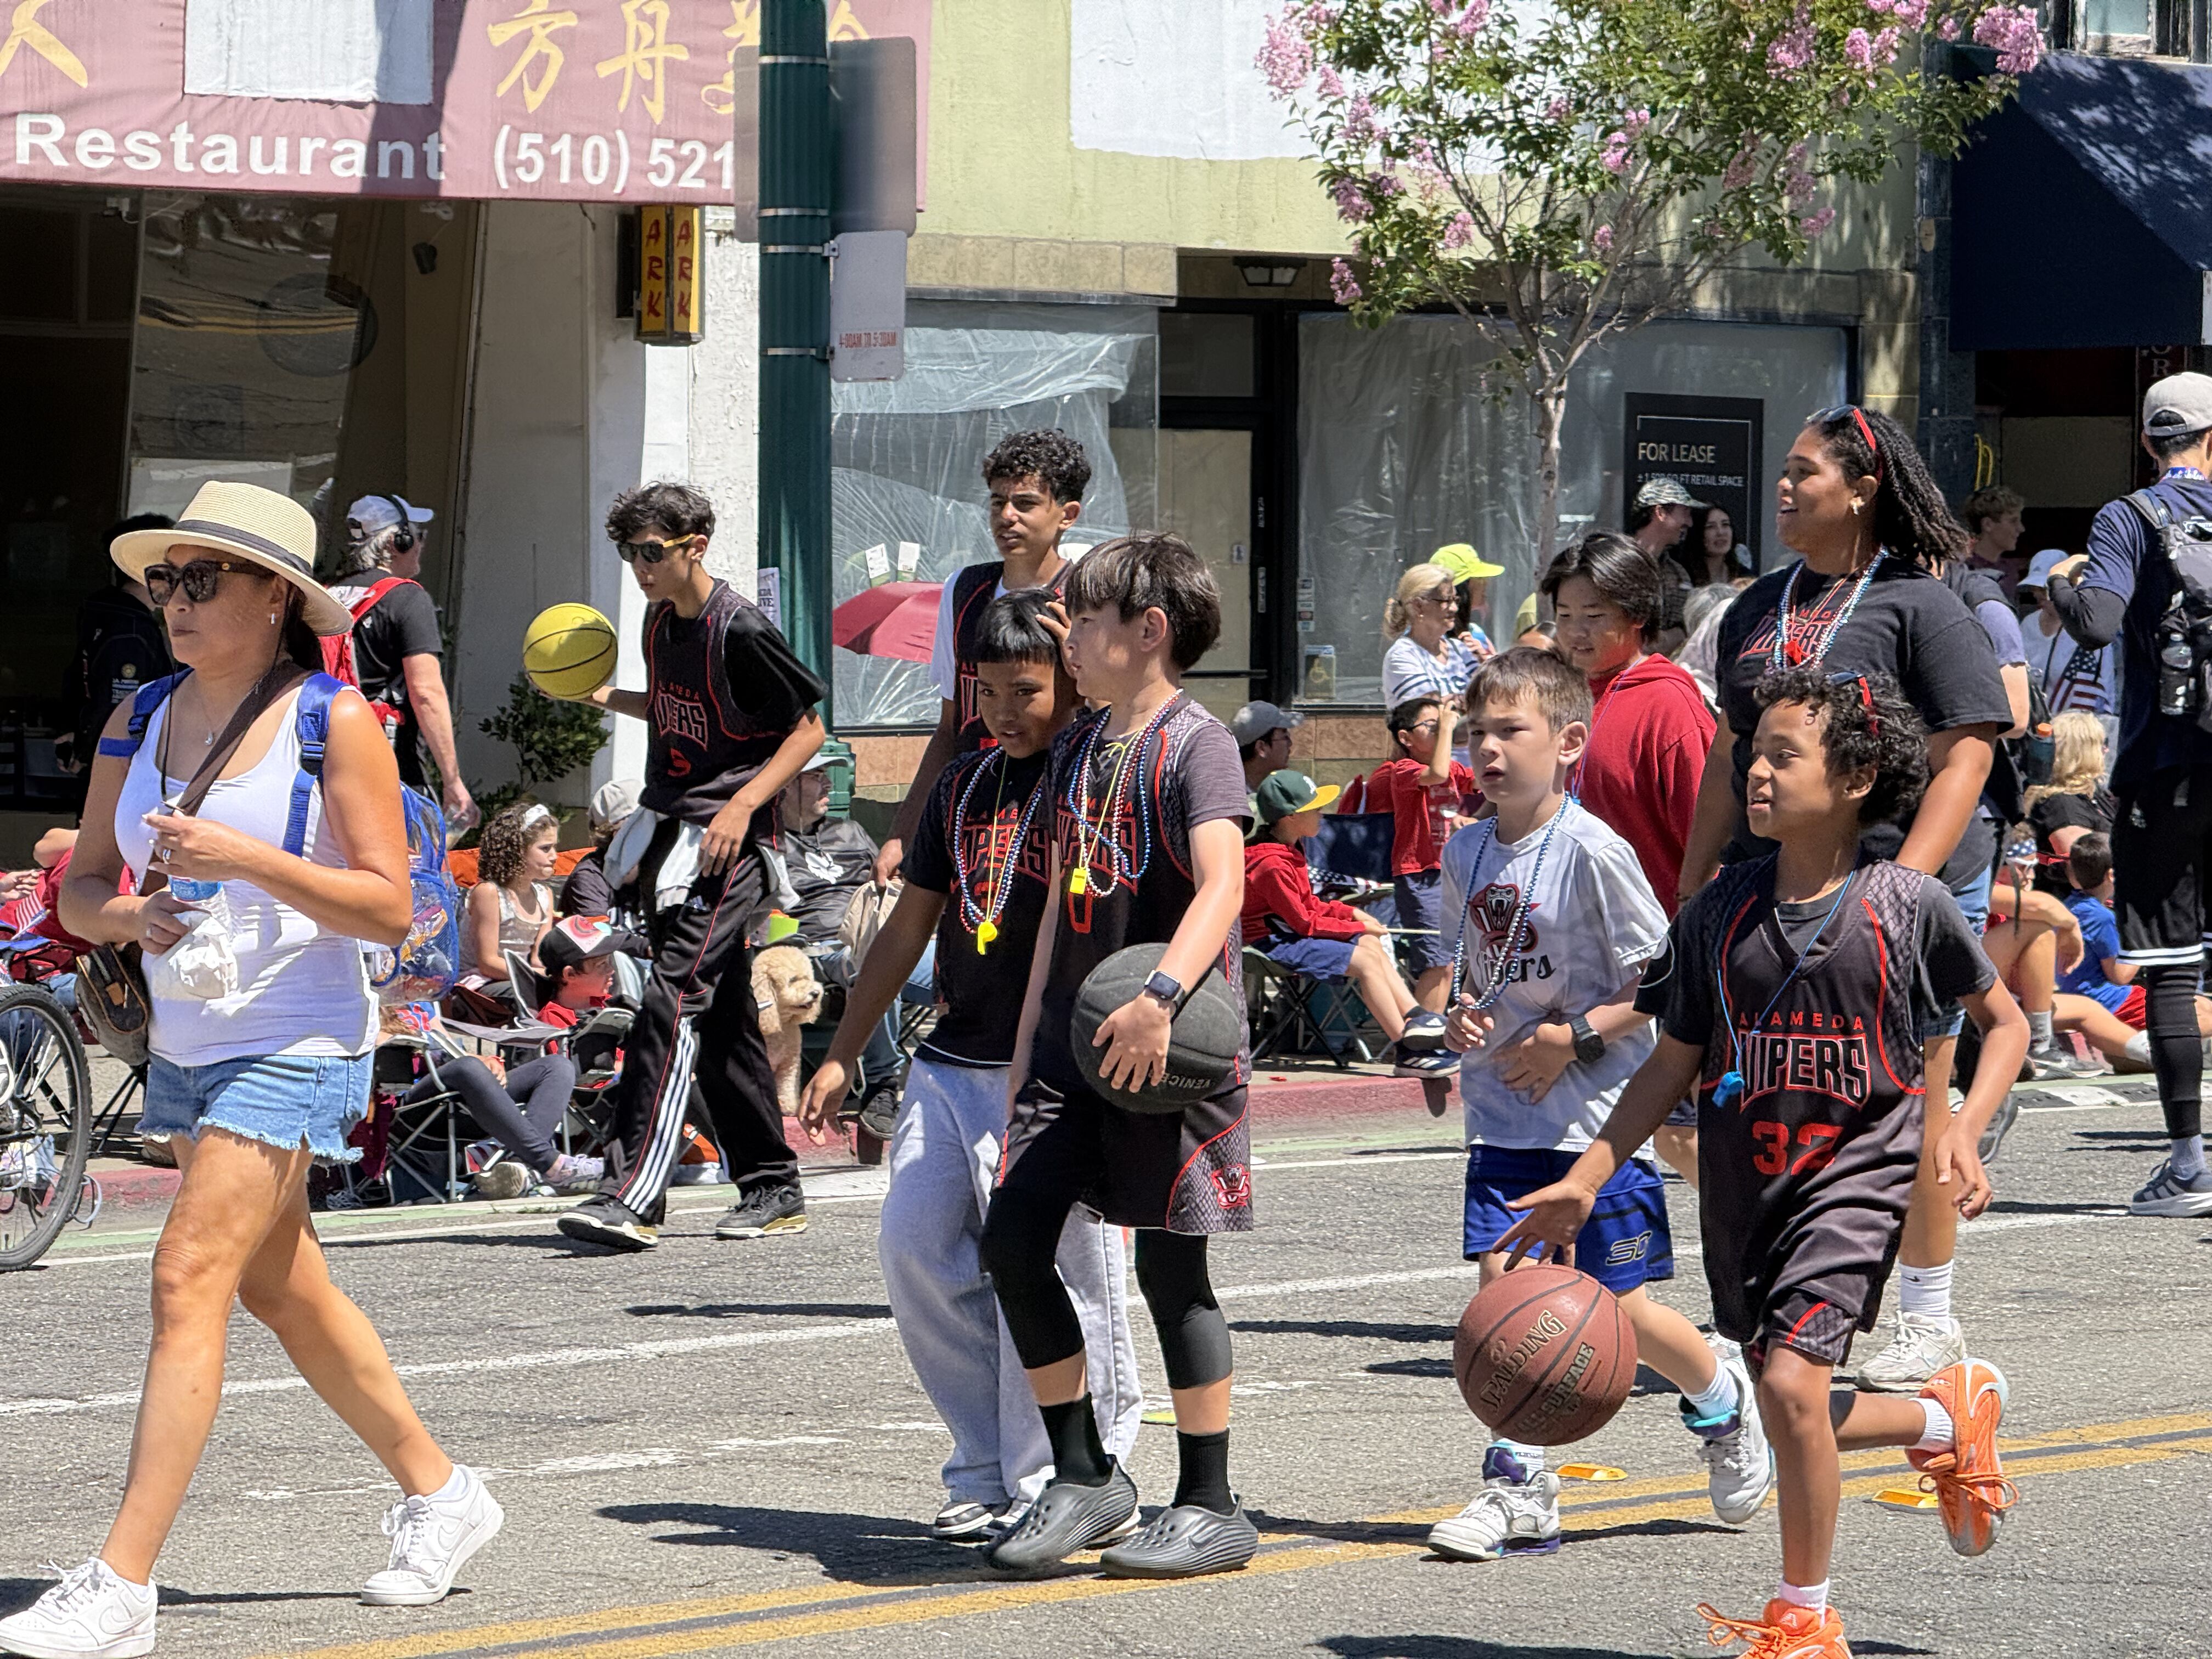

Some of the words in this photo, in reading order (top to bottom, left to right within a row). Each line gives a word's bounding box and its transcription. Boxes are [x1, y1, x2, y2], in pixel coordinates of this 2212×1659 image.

[15, 112, 446, 181] Restaurant
[494, 125, 630, 193] (510)
[647, 138, 734, 189] 521
[645, 219, 663, 318] ARK
[676, 219, 693, 319] ARK
[1638, 442, 1669, 461] FOR
[1672, 443, 1716, 464] LEASE
[1691, 474, 1718, 486] RETAIL
[1718, 475, 1745, 487] SPACE
[1738, 1029, 1871, 1114] VIPERS
[1480, 1309, 1567, 1413] SPALDING
[1540, 1341, 1595, 1415] SURFACE
